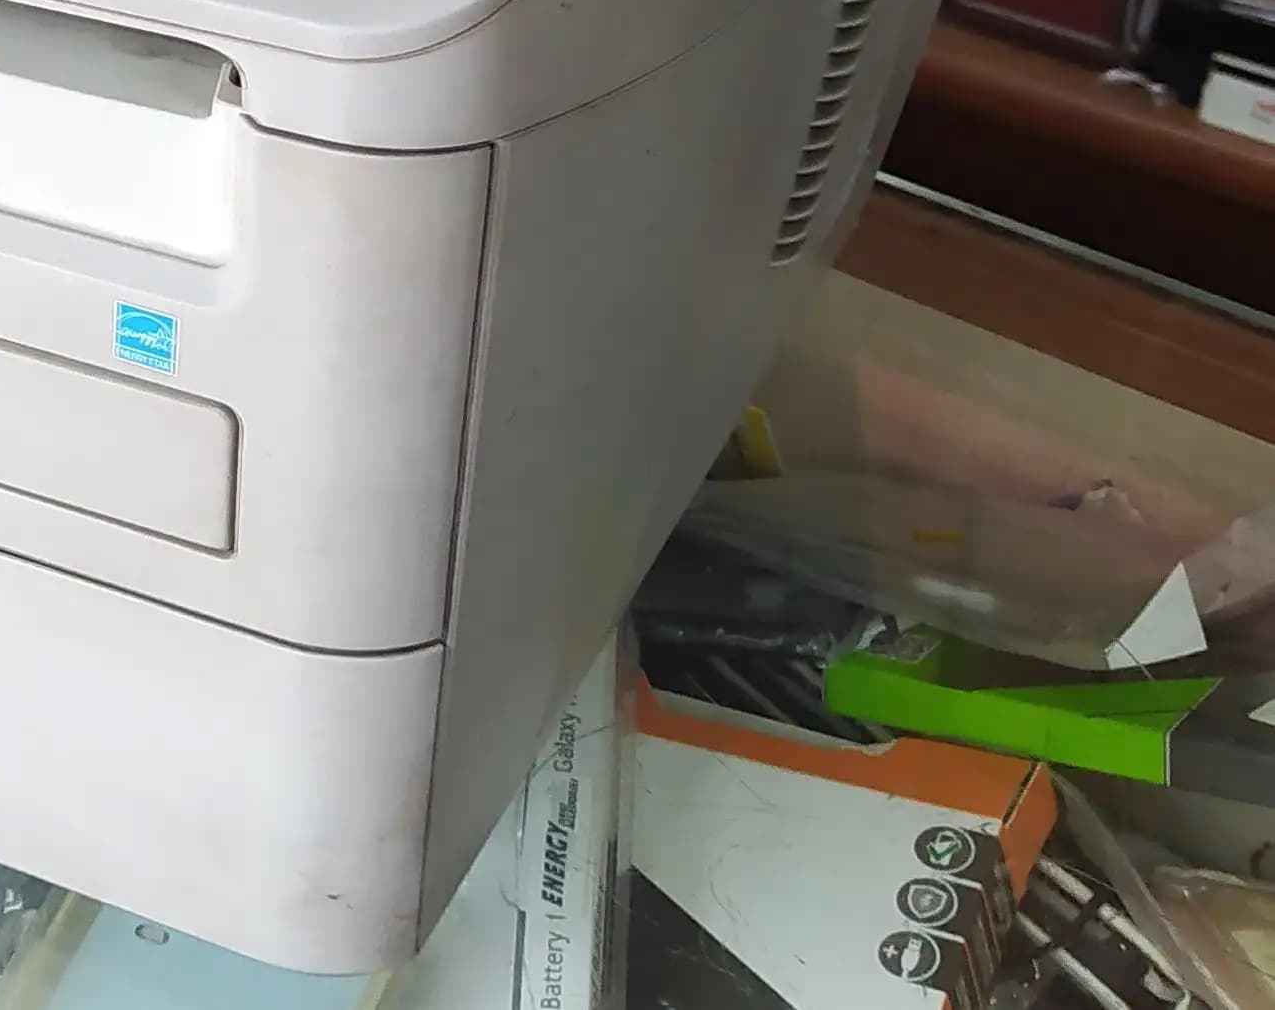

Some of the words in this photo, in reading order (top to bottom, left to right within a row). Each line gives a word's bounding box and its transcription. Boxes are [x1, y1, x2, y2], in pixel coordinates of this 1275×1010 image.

[553, 710, 581, 773] Galaxy
[541, 820, 569, 908] ENERGY
[540, 930, 571, 1010] Battery
